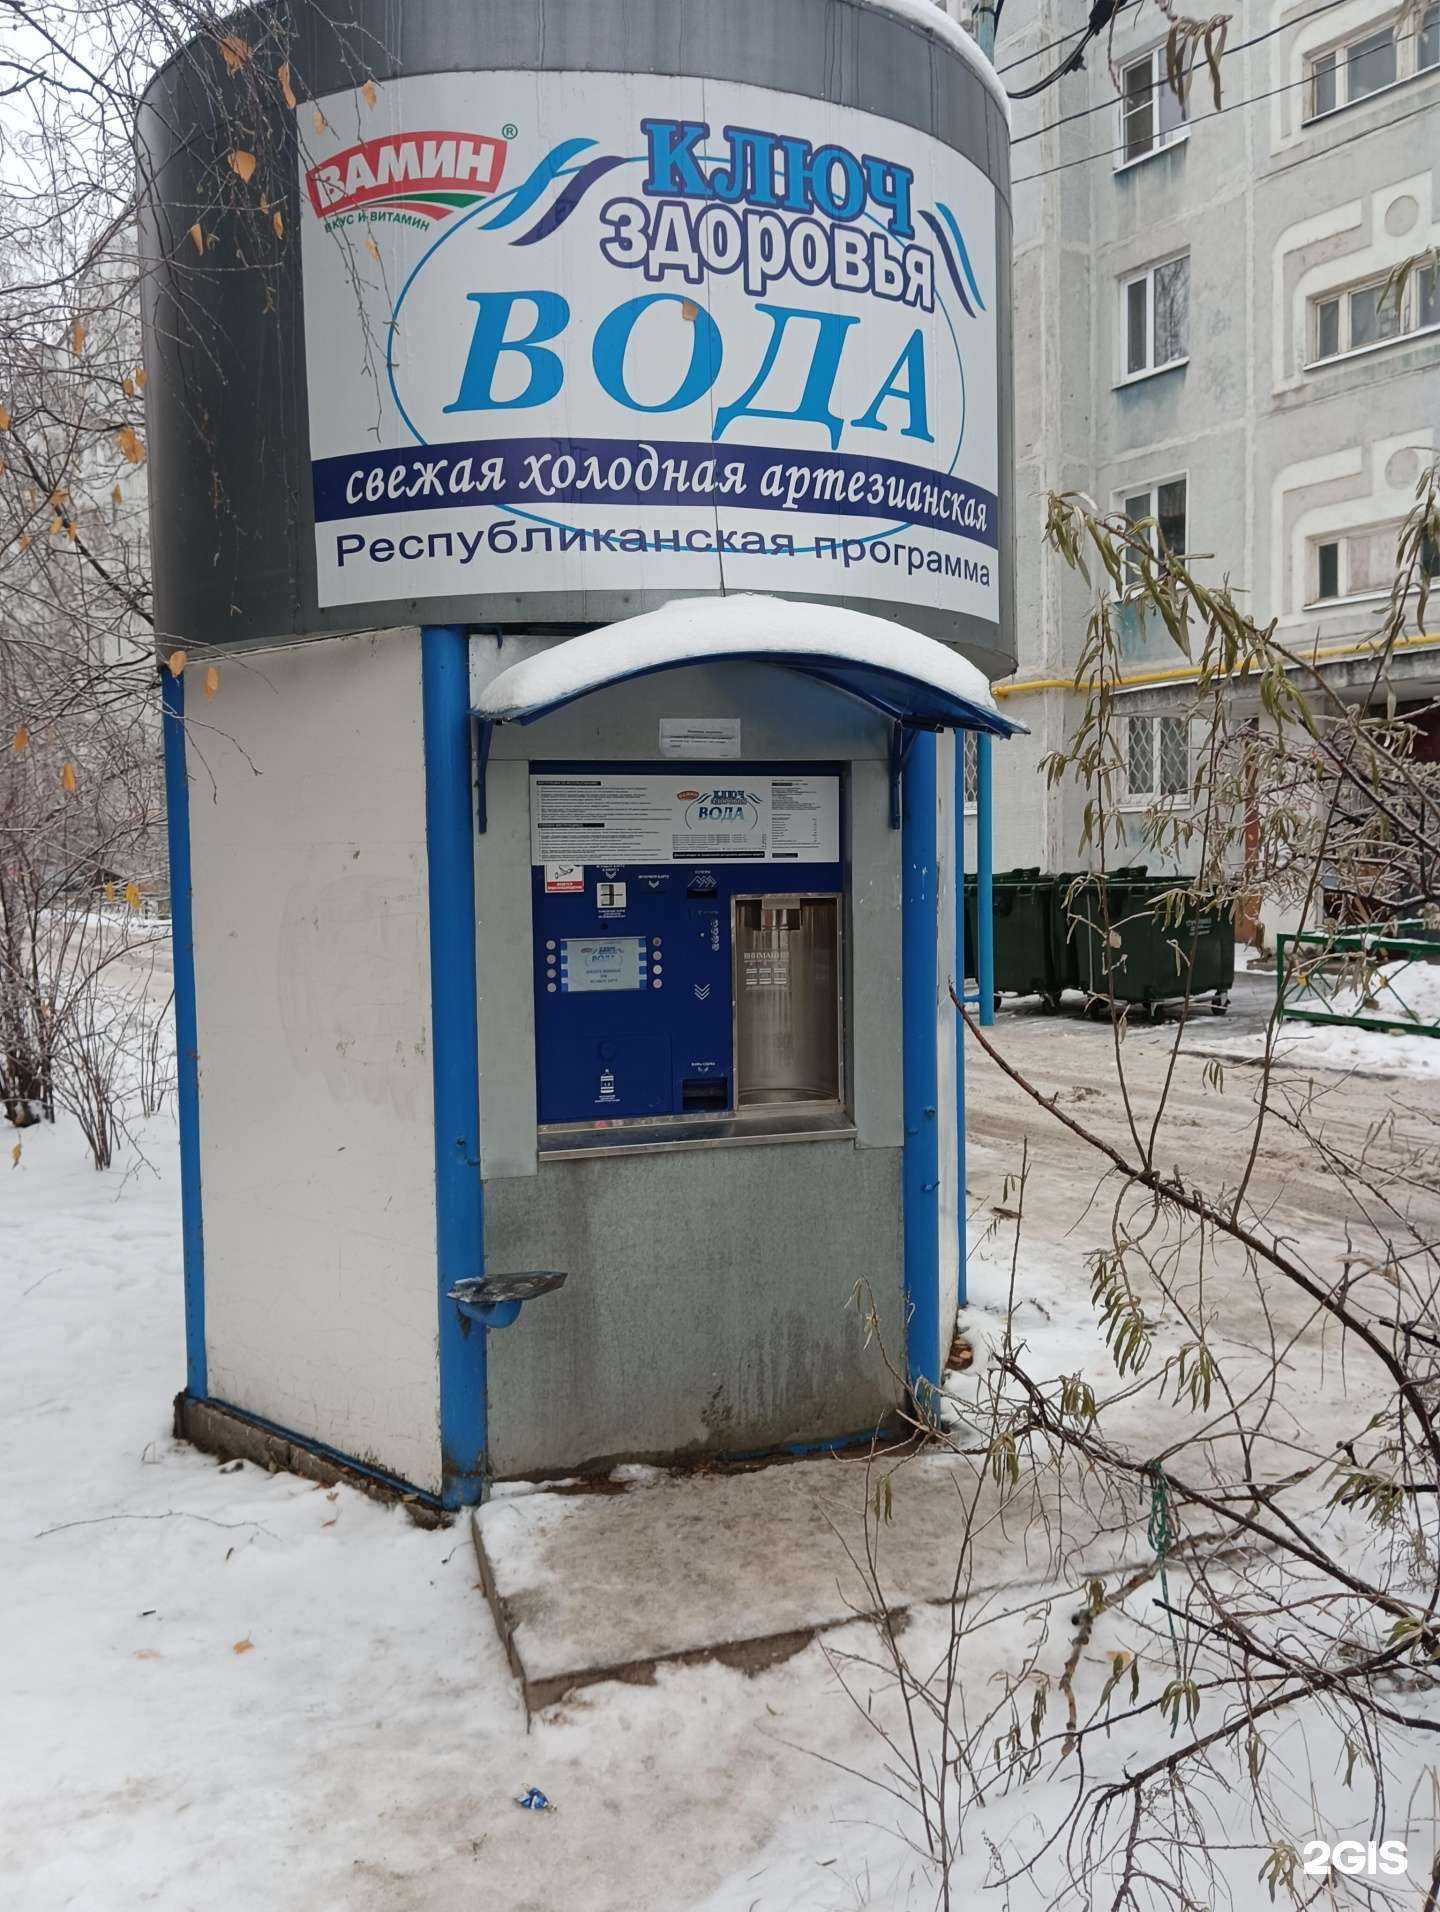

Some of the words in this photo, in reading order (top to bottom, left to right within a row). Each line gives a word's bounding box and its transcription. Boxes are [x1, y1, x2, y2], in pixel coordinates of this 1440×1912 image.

[315, 140, 495, 210] ВАМИН
[640, 118, 914, 240] КЛЮЧ
[324, 214, 354, 233] ВКУС
[370, 211, 430, 232] ВИТАМИН
[442, 290, 935, 451] ВОДА
[346, 457, 506, 505] свежая
[519, 443, 747, 496] холодная
[760, 463, 988, 532] артезианская
[336, 520, 795, 567] Республиканская
[814, 536, 990, 587] программа
[698, 806, 745, 822] ВОДА
